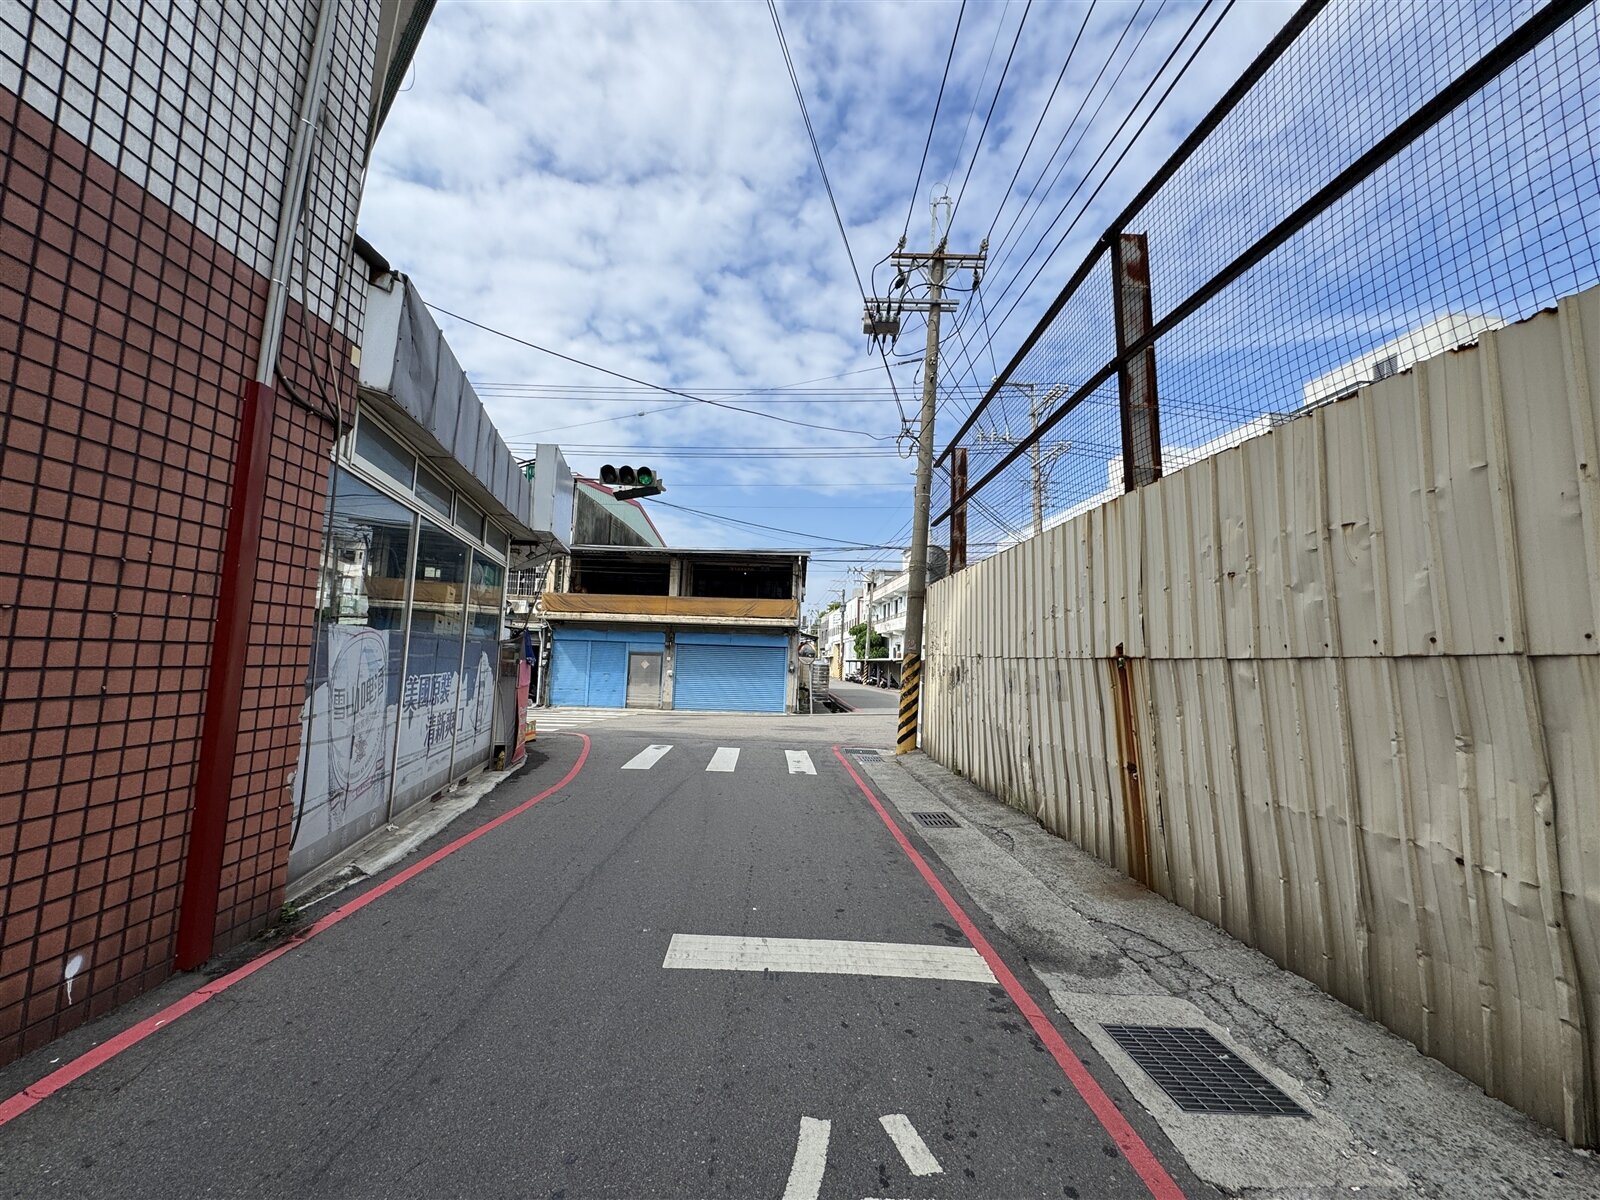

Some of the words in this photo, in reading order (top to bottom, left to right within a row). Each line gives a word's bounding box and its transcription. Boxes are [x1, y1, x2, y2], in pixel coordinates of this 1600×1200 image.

[333, 666, 384, 720] 雪山啤酒
[403, 671, 452, 713] 美國原裝
